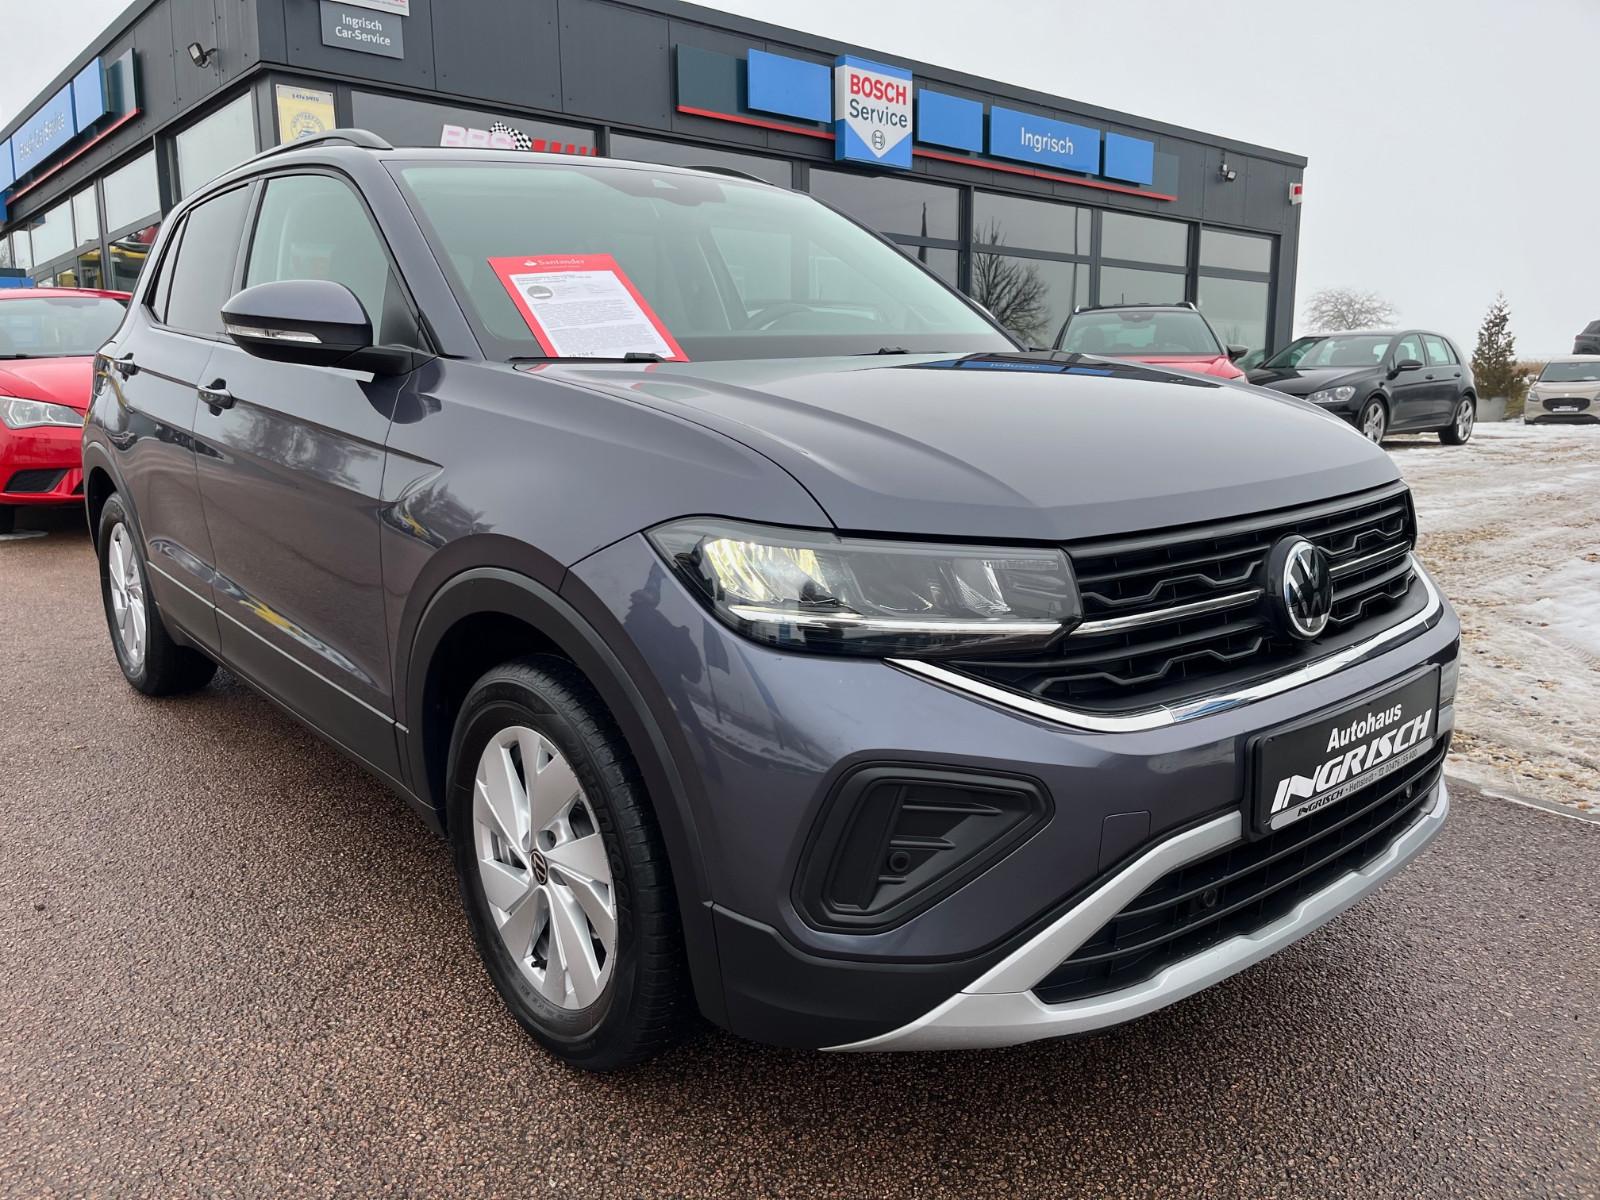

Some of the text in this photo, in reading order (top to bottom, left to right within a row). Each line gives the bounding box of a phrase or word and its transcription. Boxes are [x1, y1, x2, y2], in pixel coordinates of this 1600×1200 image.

[335, 26, 391, 46] Car-Service
[342, 13, 382, 31] Ingrisch
[850, 73, 907, 106] BOSCH
[849, 98, 908, 129] Service
[1020, 126, 1074, 155] Ingrisch
[1326, 703, 1402, 752] Autohaus
[1271, 708, 1432, 814] INGRISCH
[1297, 788, 1344, 816] INGRISCH
